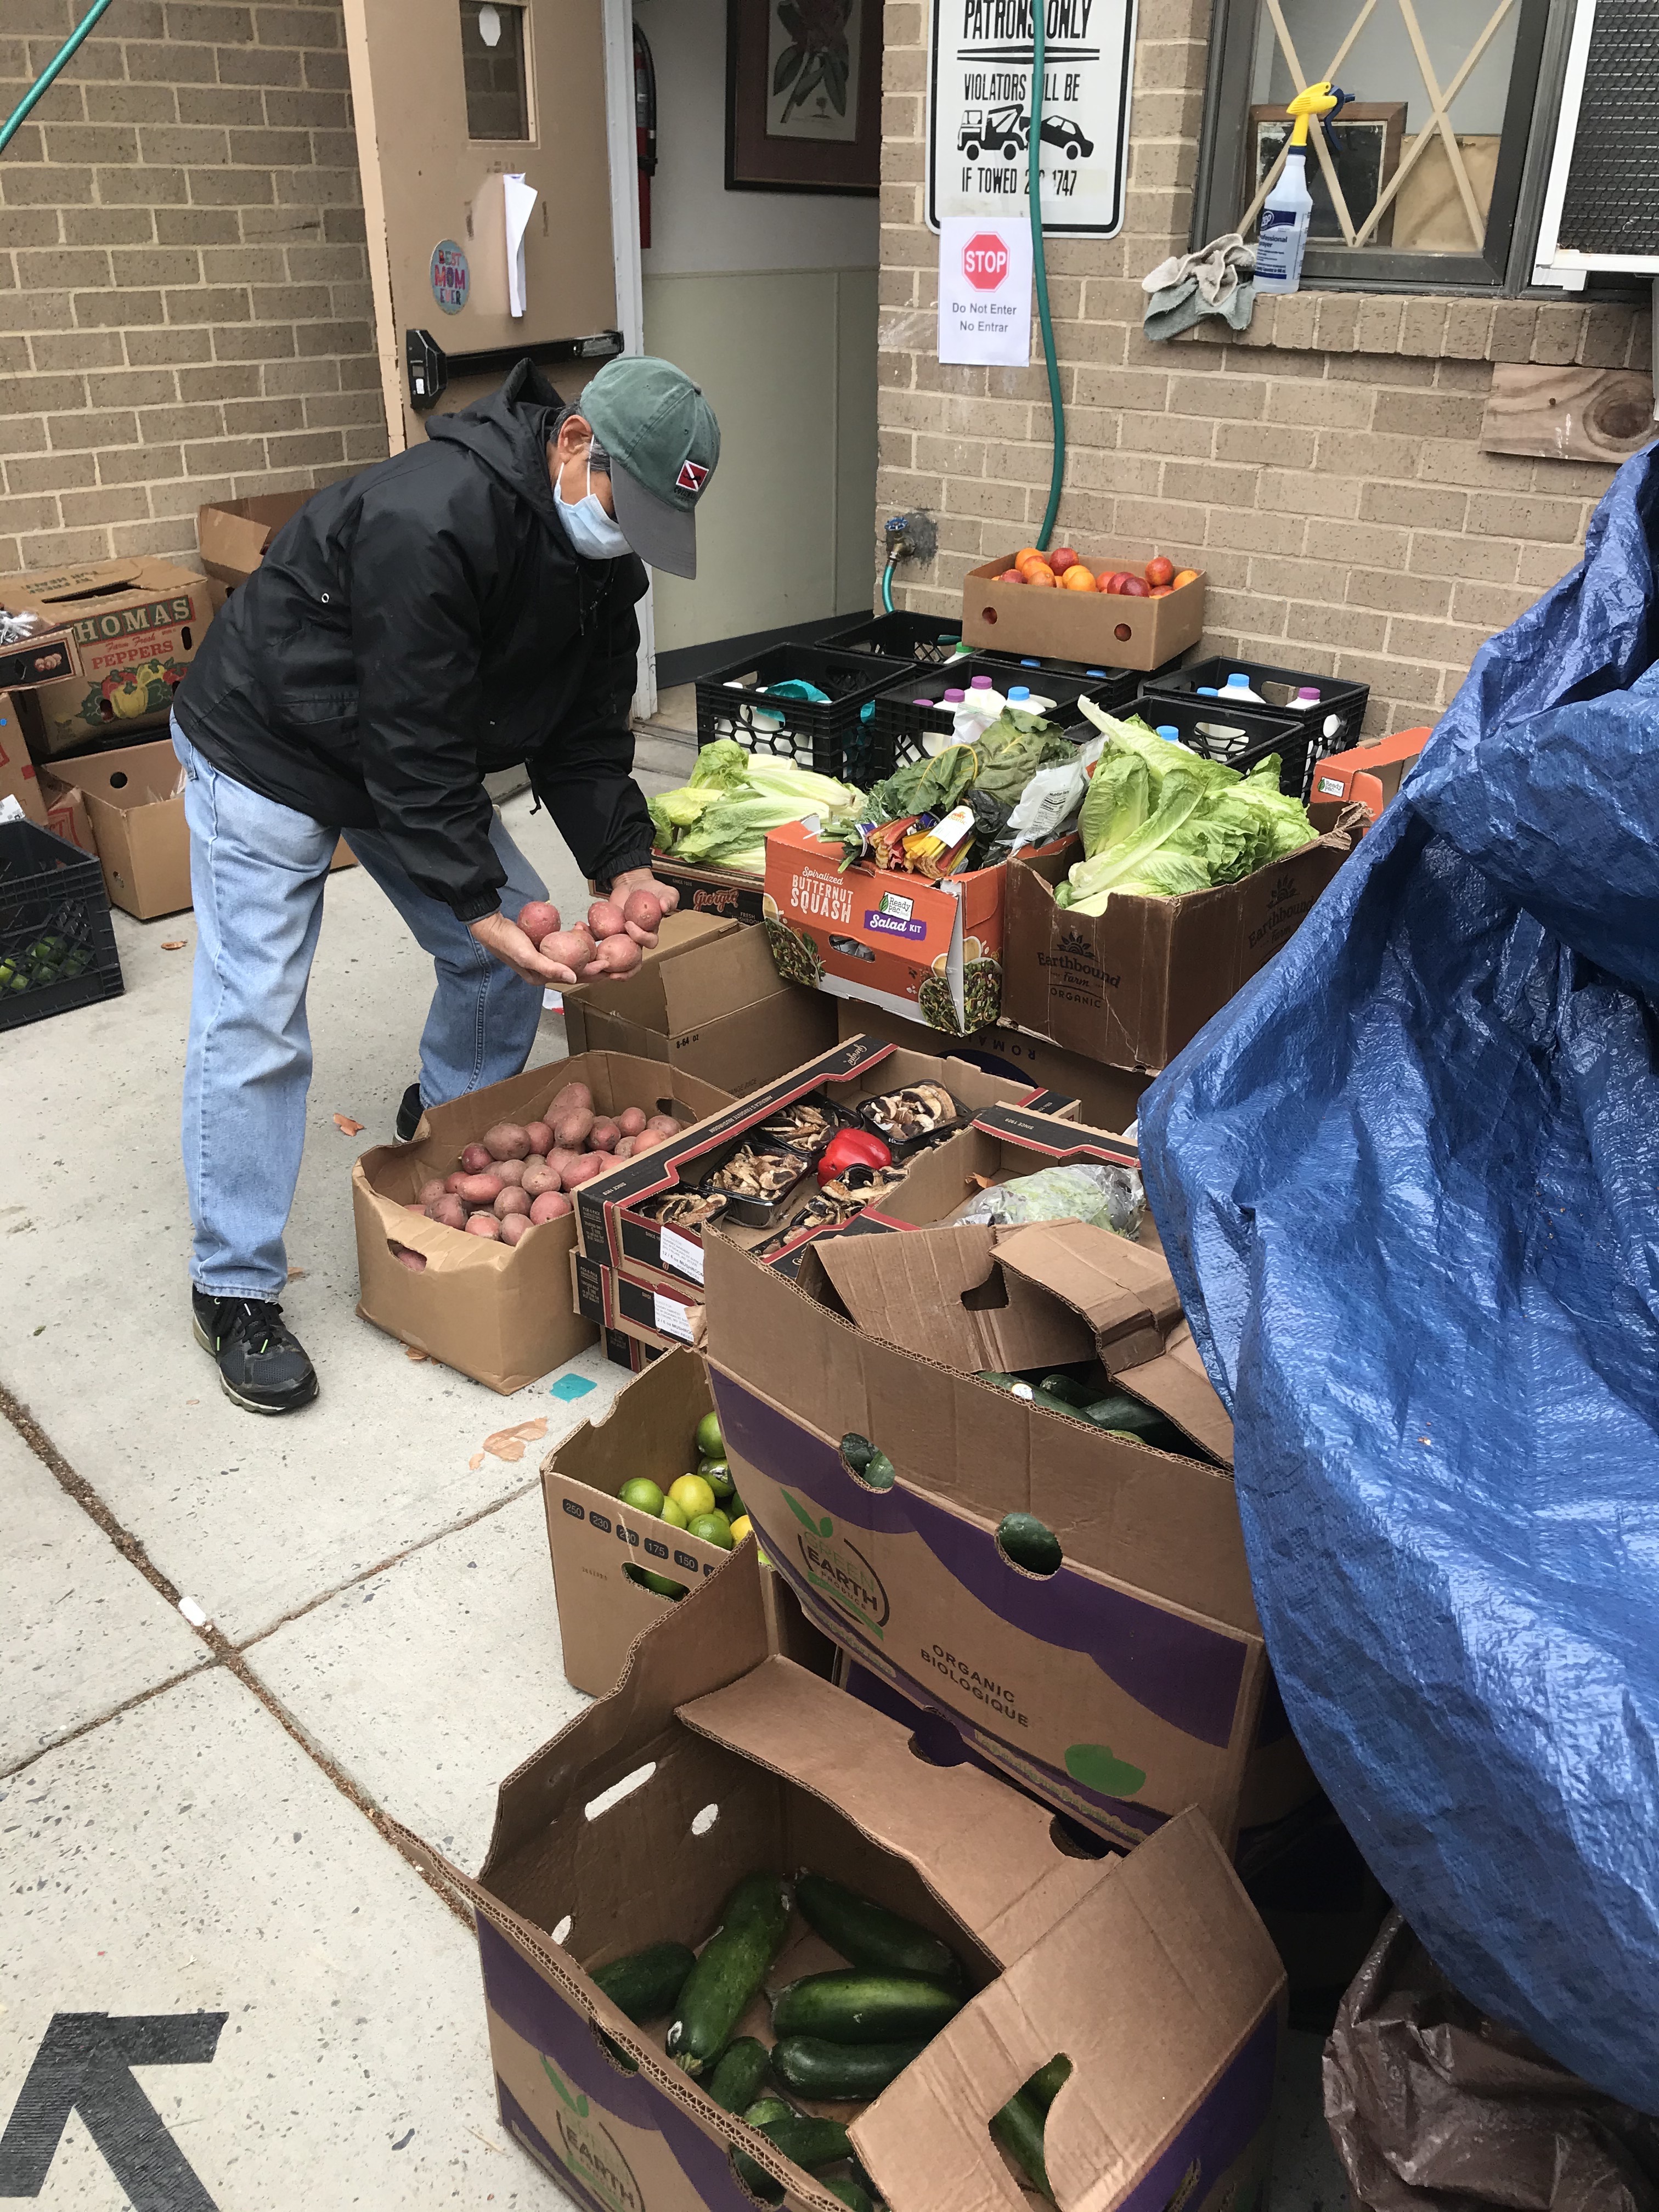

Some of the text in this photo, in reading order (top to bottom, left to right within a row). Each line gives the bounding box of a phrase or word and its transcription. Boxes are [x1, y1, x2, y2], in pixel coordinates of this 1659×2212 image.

[1047, 0, 1092, 39] ONLY
[964, 74, 1026, 101] VIOLATORS
[1064, 74, 1080, 101] BE
[962, 167, 972, 192] IF
[978, 167, 1017, 193] TOWED
[438, 250, 461, 267] BEST
[966, 251, 1006, 273] STOP
[435, 265, 465, 290] MOM
[440, 289, 461, 305] EVER
[952, 302, 1017, 315] Do Not Enter
[960, 320, 1008, 332] No Entrar
[74, 598, 190, 644] HOMAS
[92, 640, 173, 670] PEPPERS
[105, 634, 156, 653] Farm Fresh
[1325, 780, 1342, 791] Ready
[802, 866, 844, 886] Spiralized
[693, 888, 739, 913] Giorgio
[792, 874, 854, 905] BUTTERNUT
[740, 911, 756, 920] FRESH
[791, 887, 851, 924] SQUASH
[888, 905, 900, 914] pac
[889, 896, 911, 912] Ready
[870, 913, 922, 933] Salad KIT
[1037, 951, 1121, 989] Earthbound
[1063, 971, 1090, 987] Farm
[1051, 988, 1101, 1008] ORGANIC
[676, 1037, 689, 1048] 8-64
[1018, 1121, 1034, 1131] SINCE
[611, 1182, 627, 1192] SINCE
[566, 1502, 582, 1517] 250
[592, 1515, 608, 1530] 230
[648, 1543, 665, 1556] 175
[678, 1555, 696, 1569] 150
[804, 1531, 875, 1593] GREEN
[808, 1545, 878, 1611] EARTH
[821, 1571, 867, 1611] PRODUCE
[933, 1644, 1015, 1703] ORGANIC
[921, 1649, 1029, 1728] BIOLOGIQUE
[566, 2124, 635, 2209] EARTH
